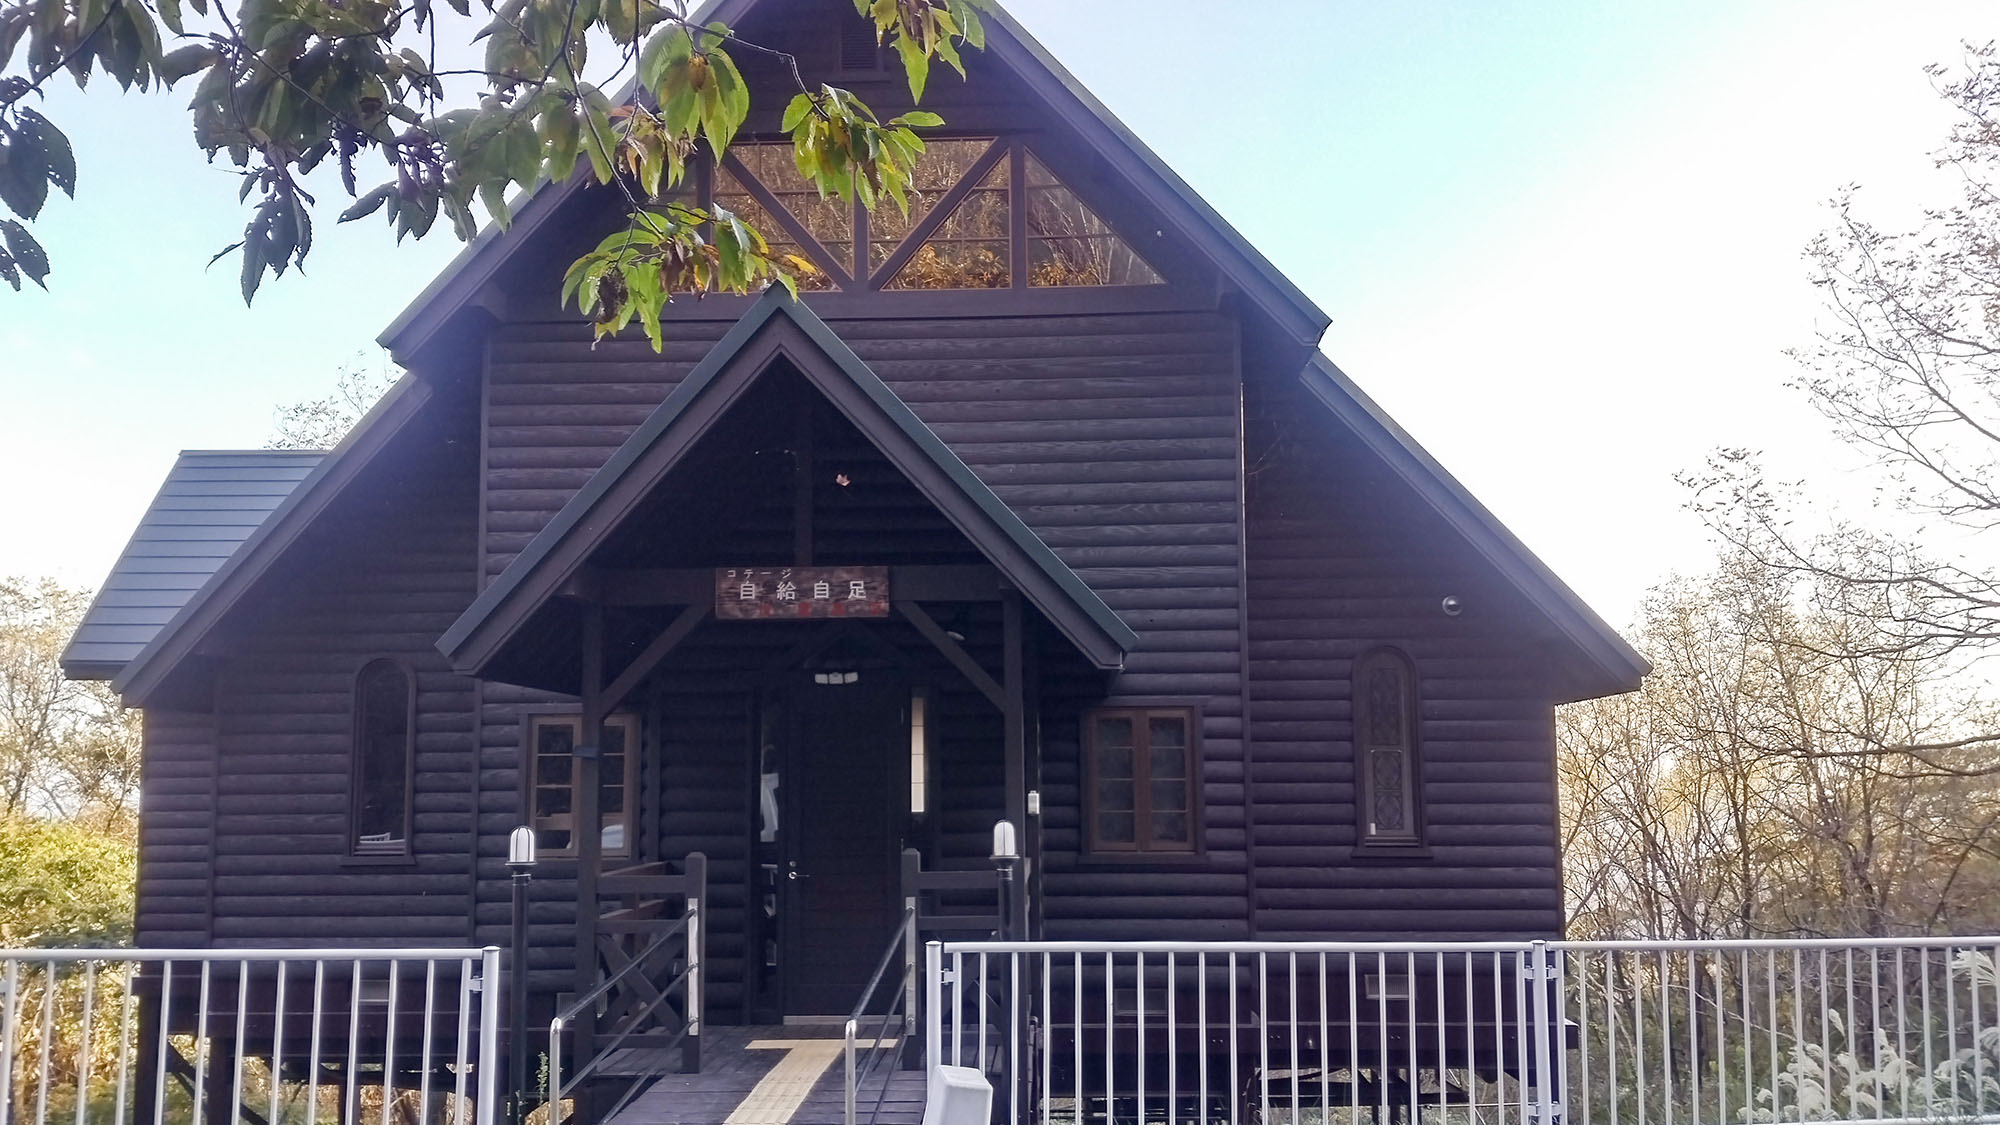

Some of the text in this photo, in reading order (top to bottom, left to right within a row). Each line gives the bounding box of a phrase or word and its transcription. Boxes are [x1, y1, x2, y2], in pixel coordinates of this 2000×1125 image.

[727, 568, 792, 579] コテージ
[740, 580, 867, 600] 自給自足
